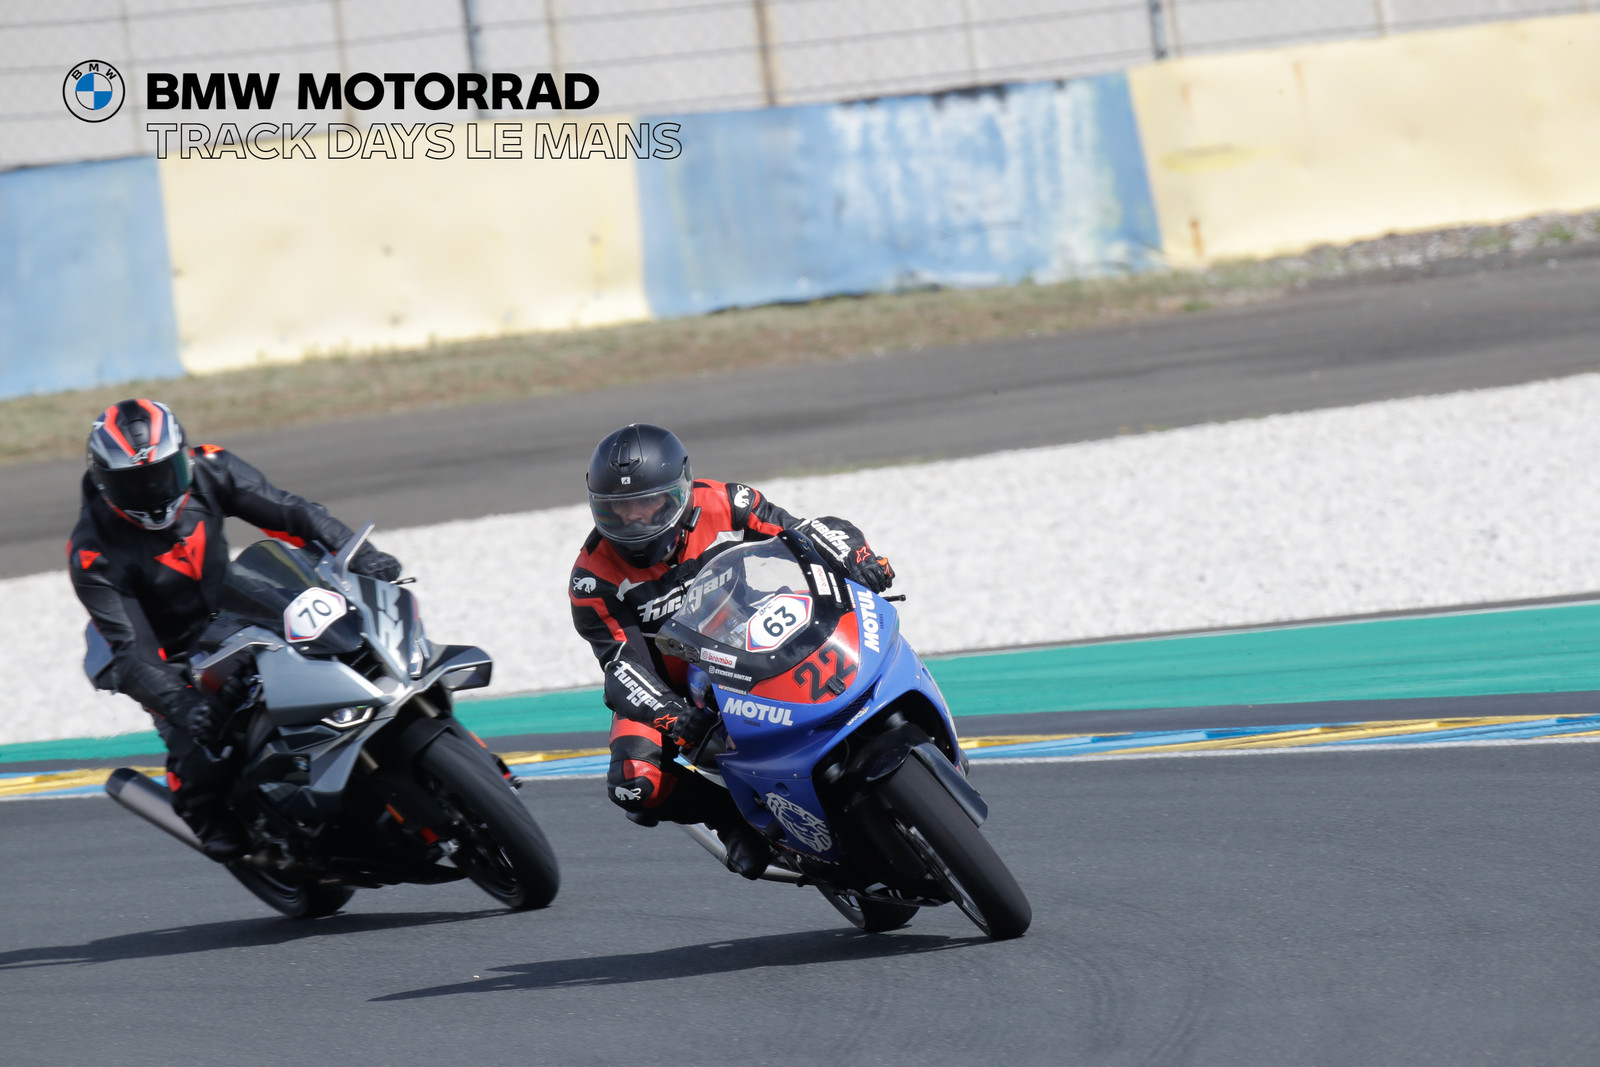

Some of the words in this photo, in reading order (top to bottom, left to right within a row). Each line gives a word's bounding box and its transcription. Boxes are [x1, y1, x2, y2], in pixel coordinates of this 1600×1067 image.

[297, 599, 332, 629] 70
[763, 605, 797, 638] 63
[856, 589, 880, 654] MOTUL
[708, 654, 733, 666] brembo
[792, 645, 858, 704] 22
[723, 697, 794, 727] MOTUL
